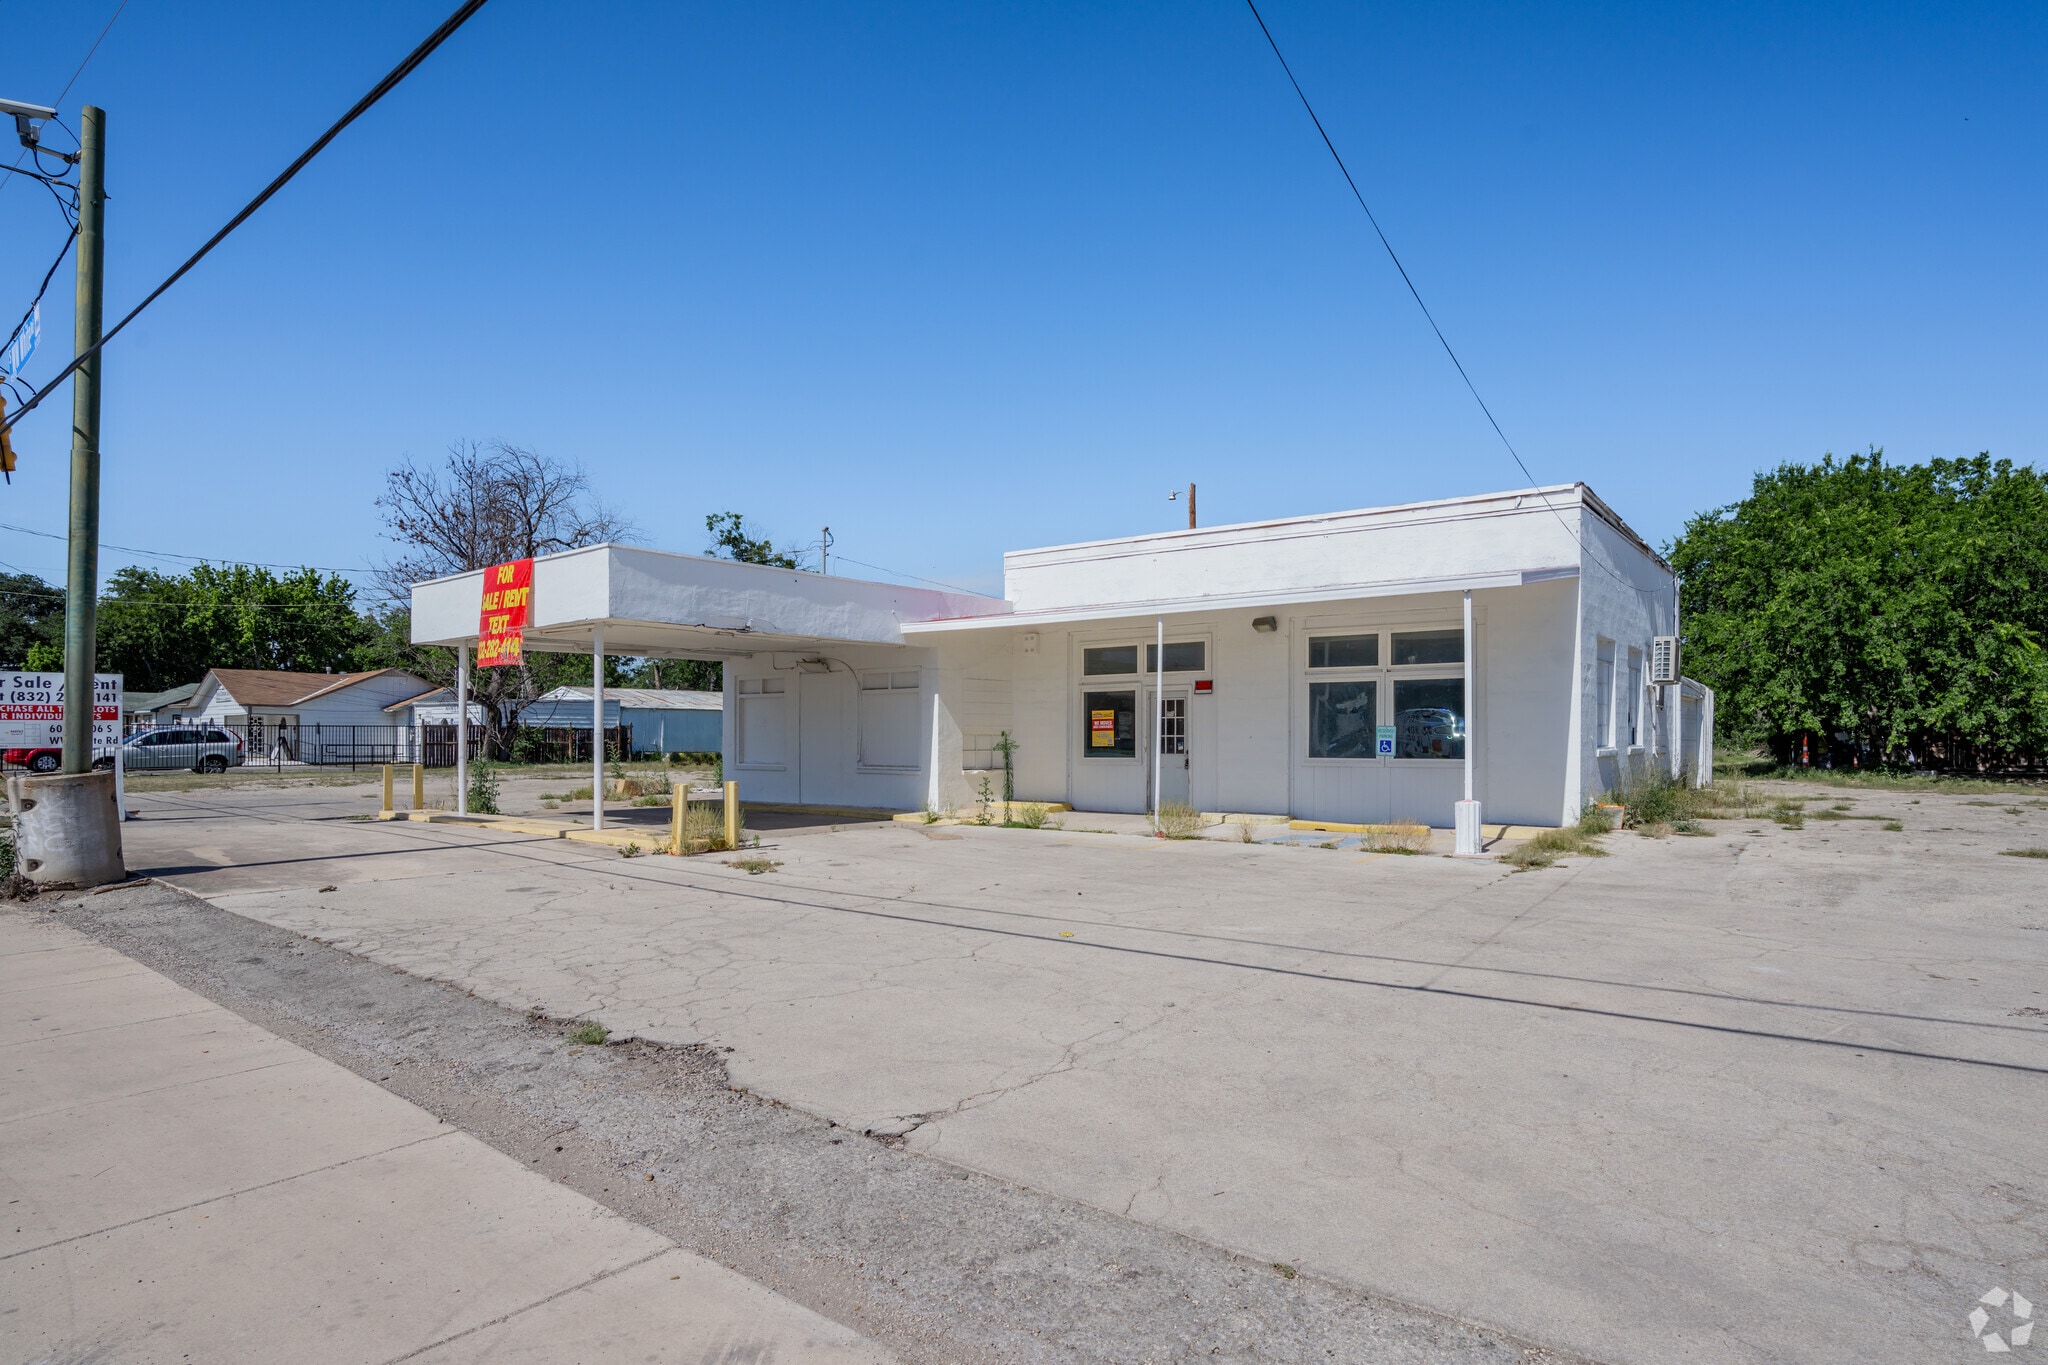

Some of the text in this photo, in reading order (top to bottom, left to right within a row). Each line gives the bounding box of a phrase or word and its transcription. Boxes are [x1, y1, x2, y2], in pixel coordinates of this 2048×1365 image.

[497, 564, 514, 585] FOR
[489, 614, 510, 635] TEXT
[13, 675, 52, 689] Sale
[93, 680, 117, 690] ent
[10, 691, 50, 704] (832)
[49, 725, 63, 733] 60
[106, 724, 112, 733] S
[106, 735, 118, 745] Rd
